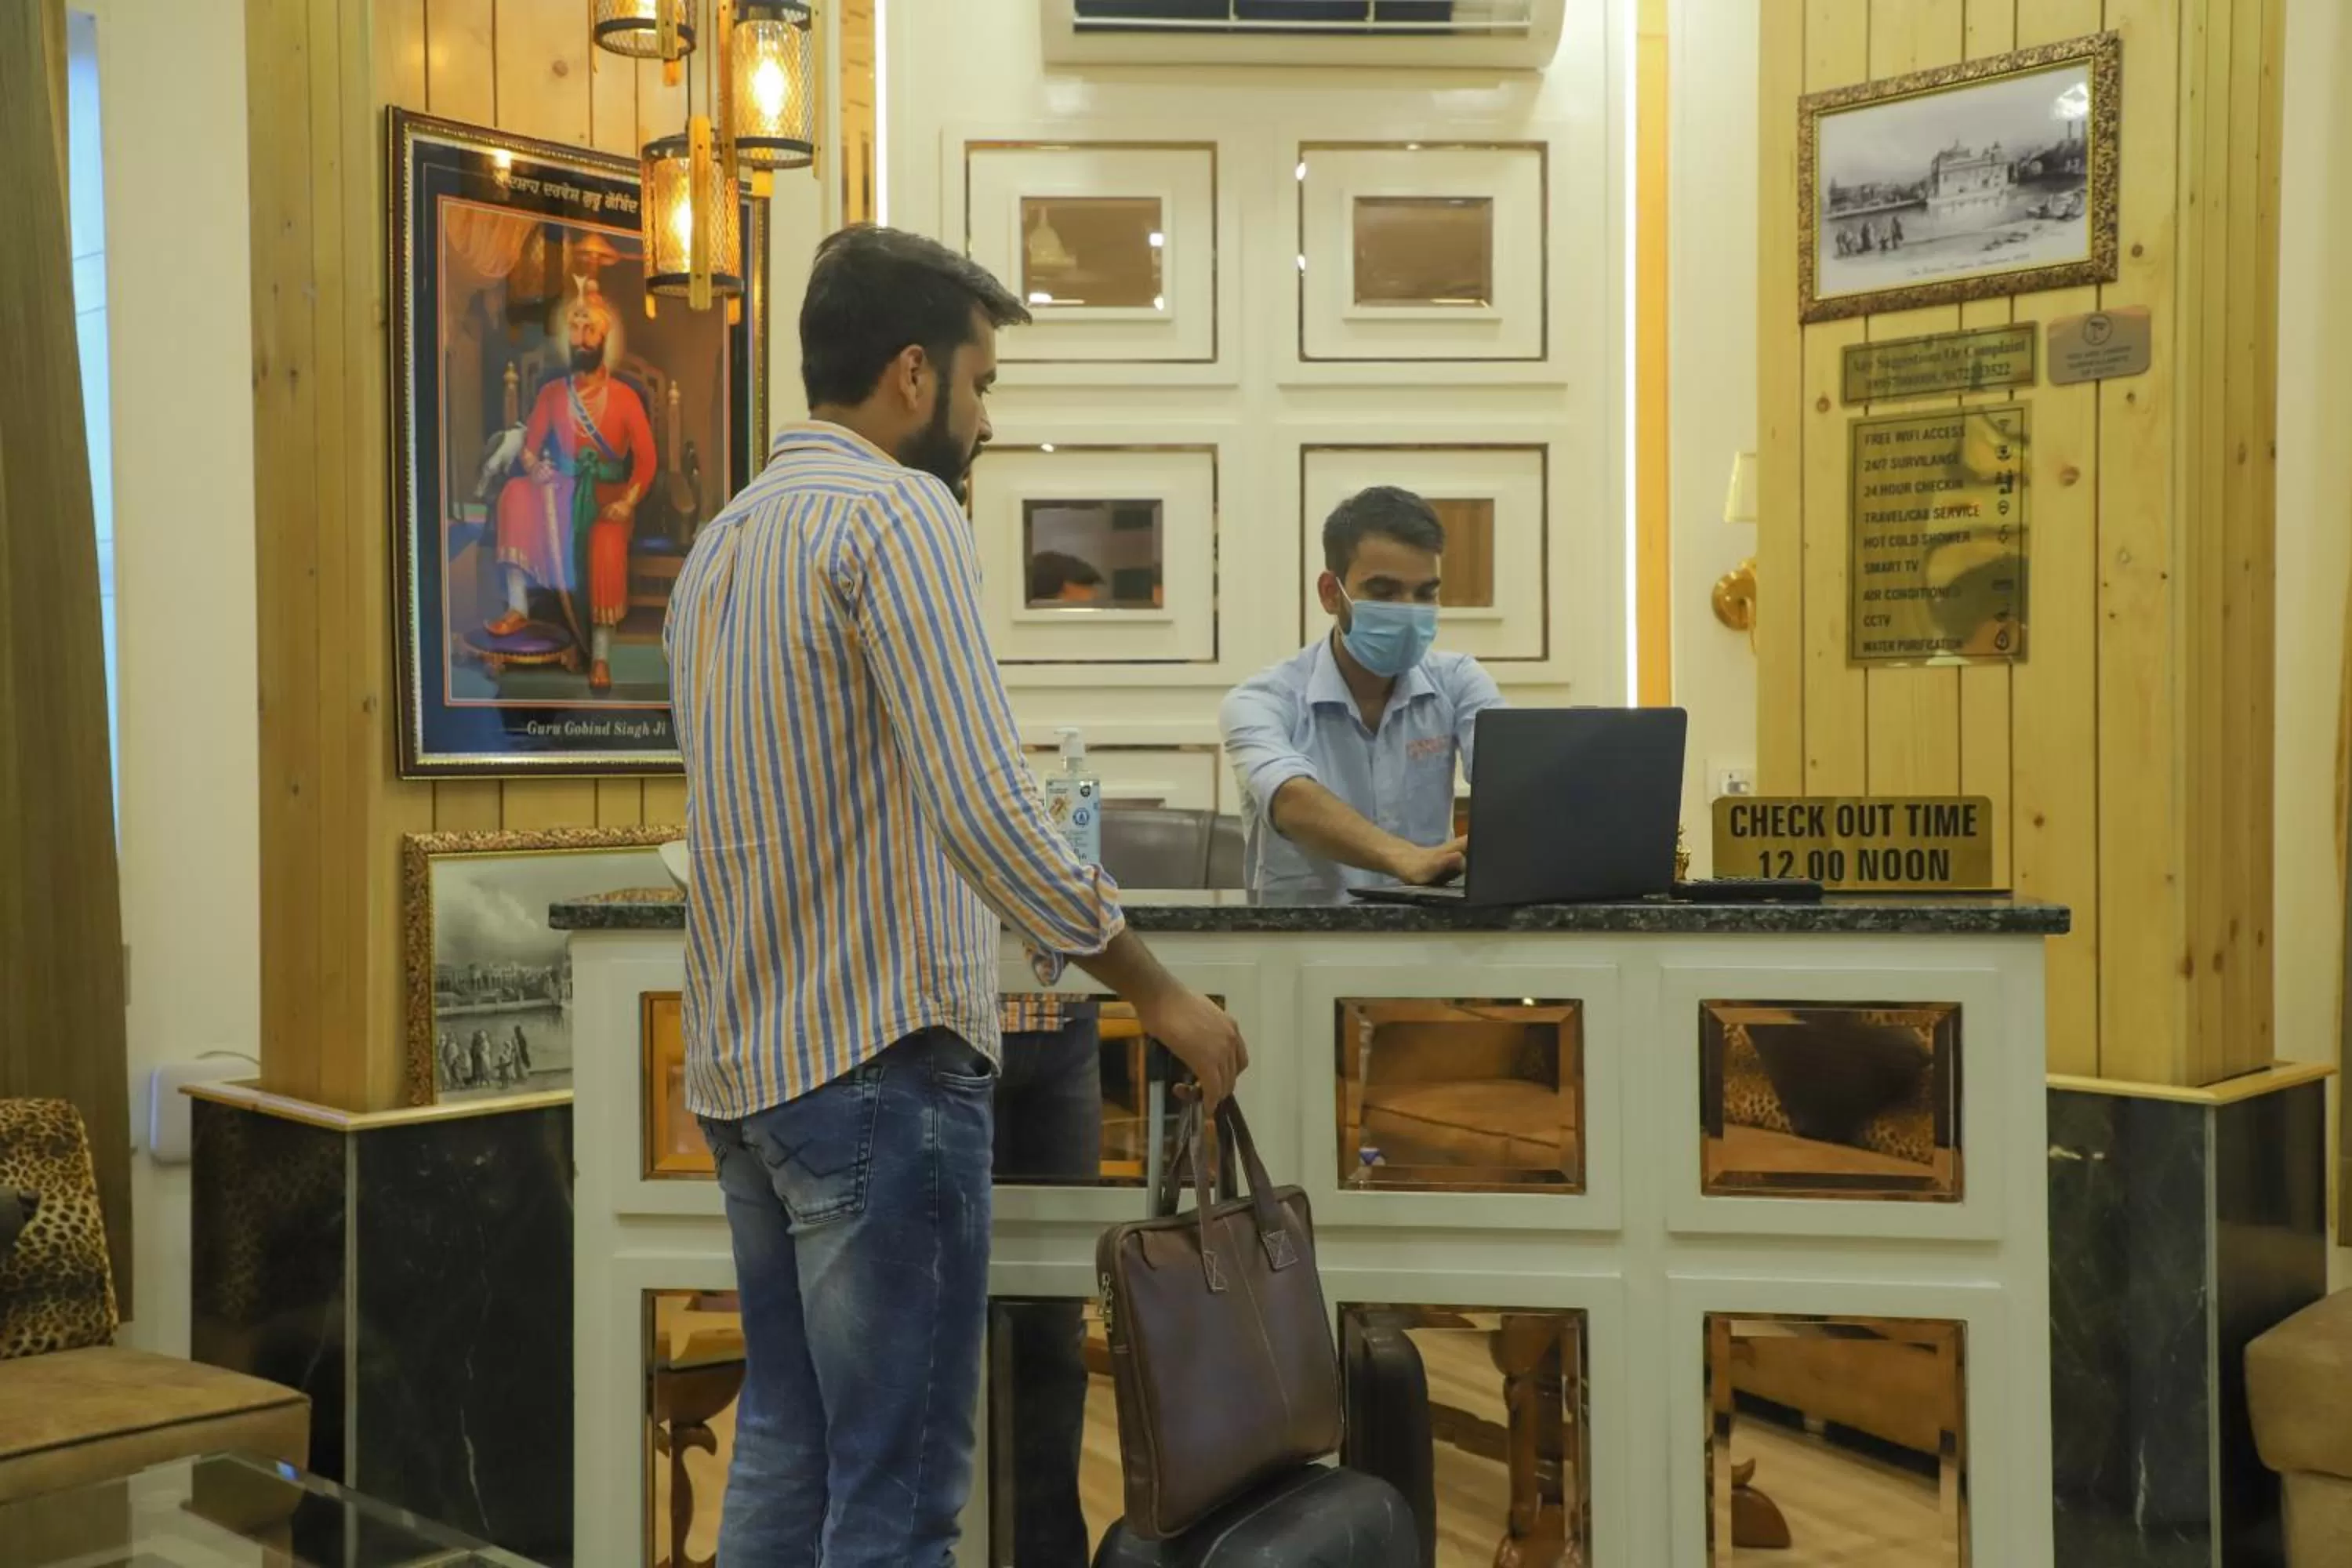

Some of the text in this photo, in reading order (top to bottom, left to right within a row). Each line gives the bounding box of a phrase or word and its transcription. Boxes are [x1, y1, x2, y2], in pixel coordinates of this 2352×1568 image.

[1865, 433, 1890, 445] FREE
[1922, 426, 1965, 440] ACCESS
[1864, 485, 1877, 498] 24
[1879, 482, 1912, 495] HOUR
[1933, 504, 1980, 520] SERVICE
[1864, 532, 1970, 548] HOT COLD SHOWER
[1864, 559, 1918, 575] SMART TV
[1863, 590, 1882, 601] AIR
[1864, 615, 1892, 627] CCTV
[1863, 641, 1896, 653] WATER
[527, 720, 666, 738] Guru Gobind Singh Ji
[1730, 804, 1977, 838] CHECK OUT TIME
[1857, 848, 1950, 881] NOON
